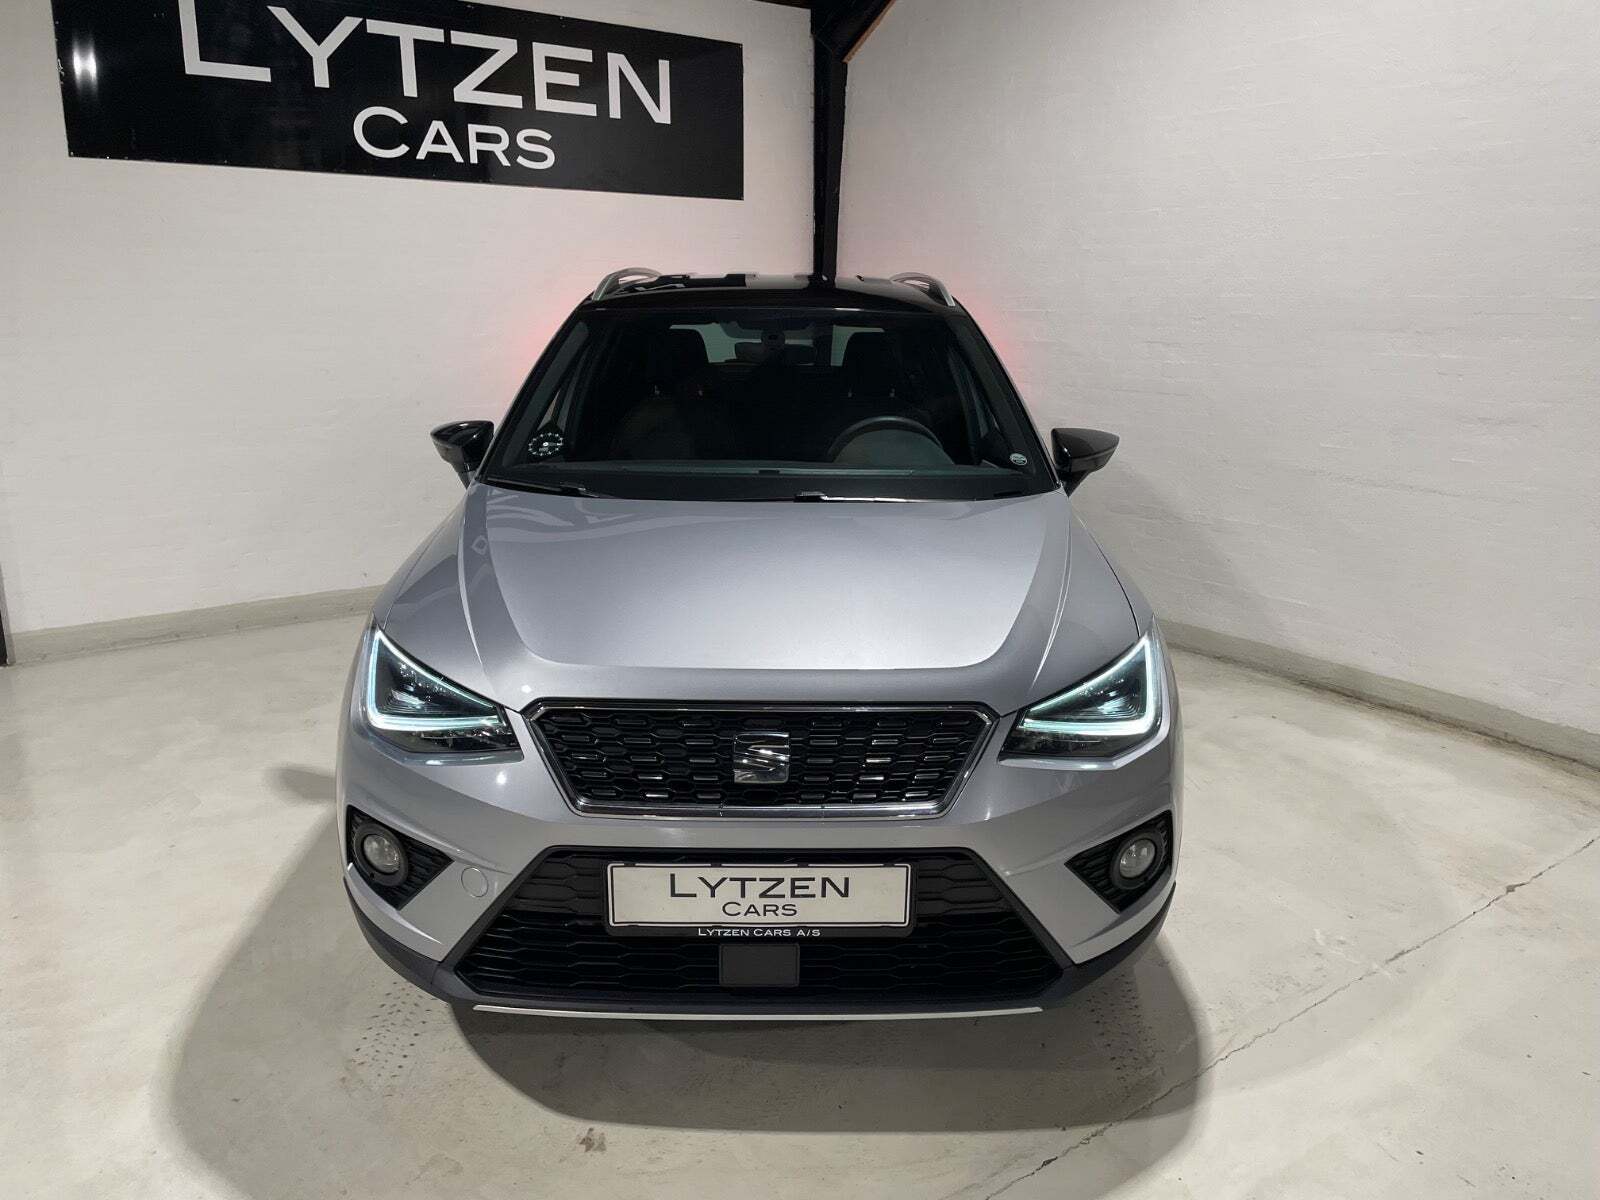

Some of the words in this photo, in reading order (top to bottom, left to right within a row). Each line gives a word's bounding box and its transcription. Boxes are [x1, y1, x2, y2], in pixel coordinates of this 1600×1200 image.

[178, 0, 672, 125] LYTZEN
[353, 105, 556, 170] CARS
[669, 873, 850, 899] LYTZEN
[721, 901, 798, 917] CARS
[698, 927, 750, 937] LYTZEN
[753, 927, 792, 937] CARS
[796, 928, 821, 937] A/S
